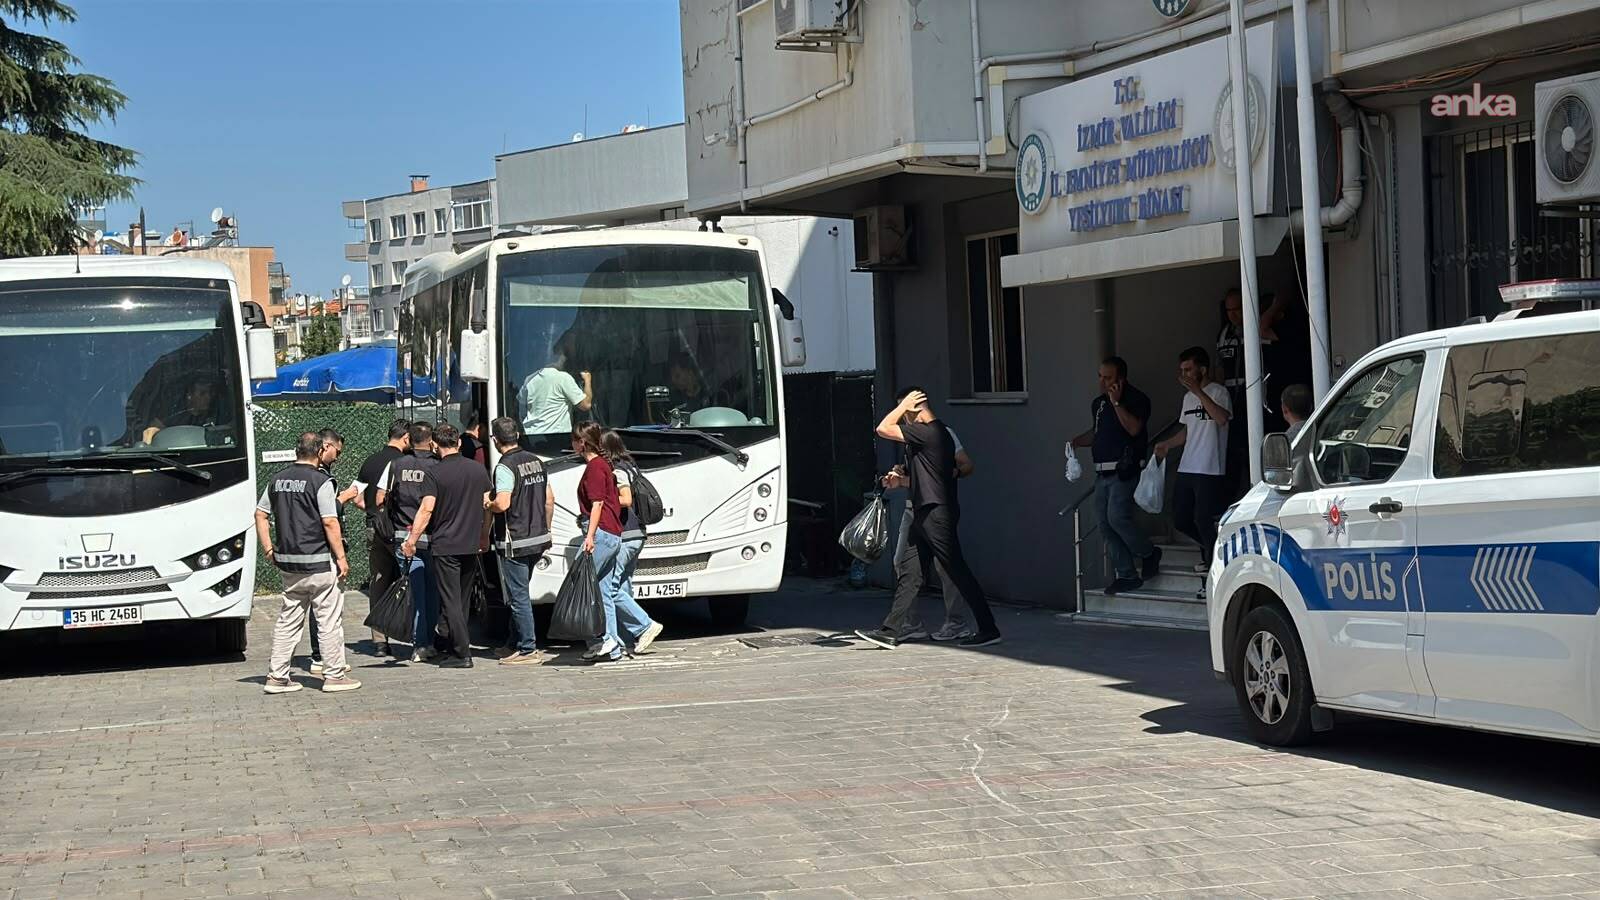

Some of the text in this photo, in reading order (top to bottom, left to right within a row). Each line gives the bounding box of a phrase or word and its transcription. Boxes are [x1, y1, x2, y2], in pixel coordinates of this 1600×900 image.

[1077, 117, 1115, 152] İZMİR
[402, 469, 425, 483] KO
[275, 479, 307, 493] KOM
[59, 554, 136, 570] ISUZU
[1324, 552, 1397, 601] POLİS
[638, 584, 681, 597] AJ 4255
[72, 607, 138, 623] 35 HC 2468
